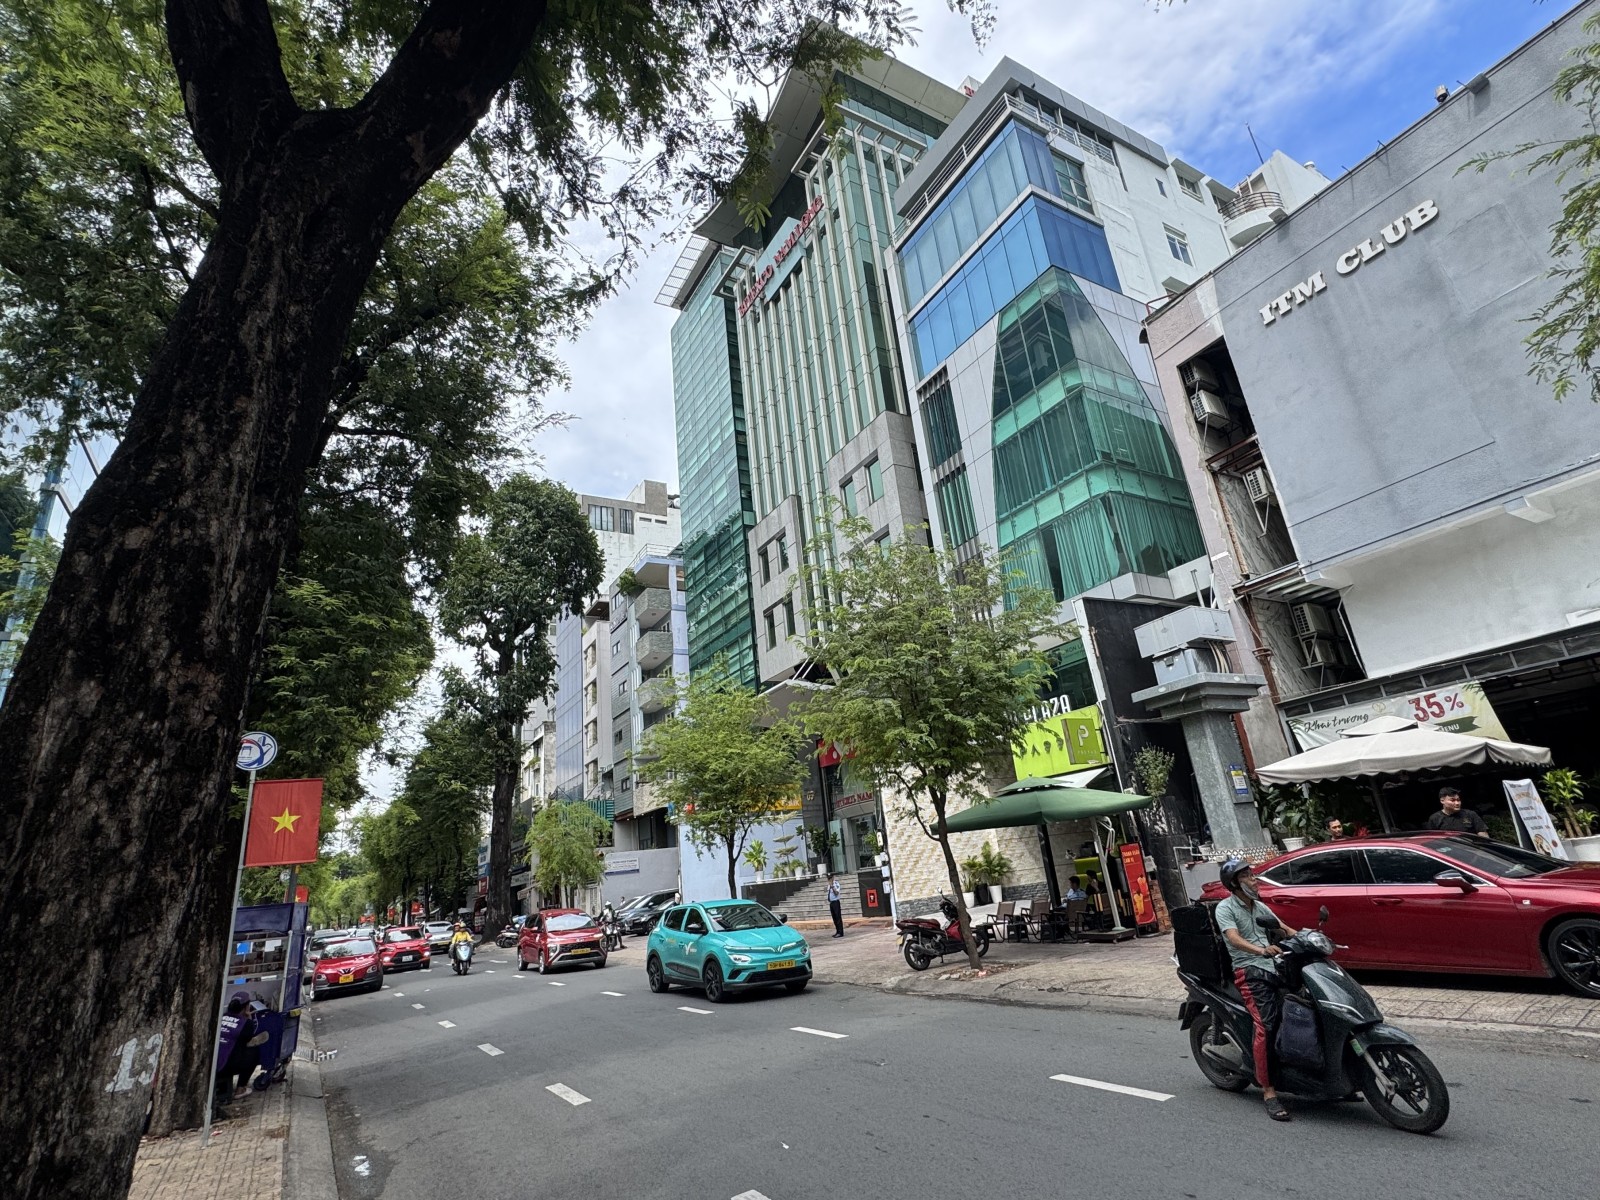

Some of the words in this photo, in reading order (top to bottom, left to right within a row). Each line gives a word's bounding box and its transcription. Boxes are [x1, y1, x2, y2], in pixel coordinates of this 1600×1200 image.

[1259, 271, 1328, 325] ITM
[1336, 199, 1439, 276] CLUB
[105, 1033, 164, 1093] 13
